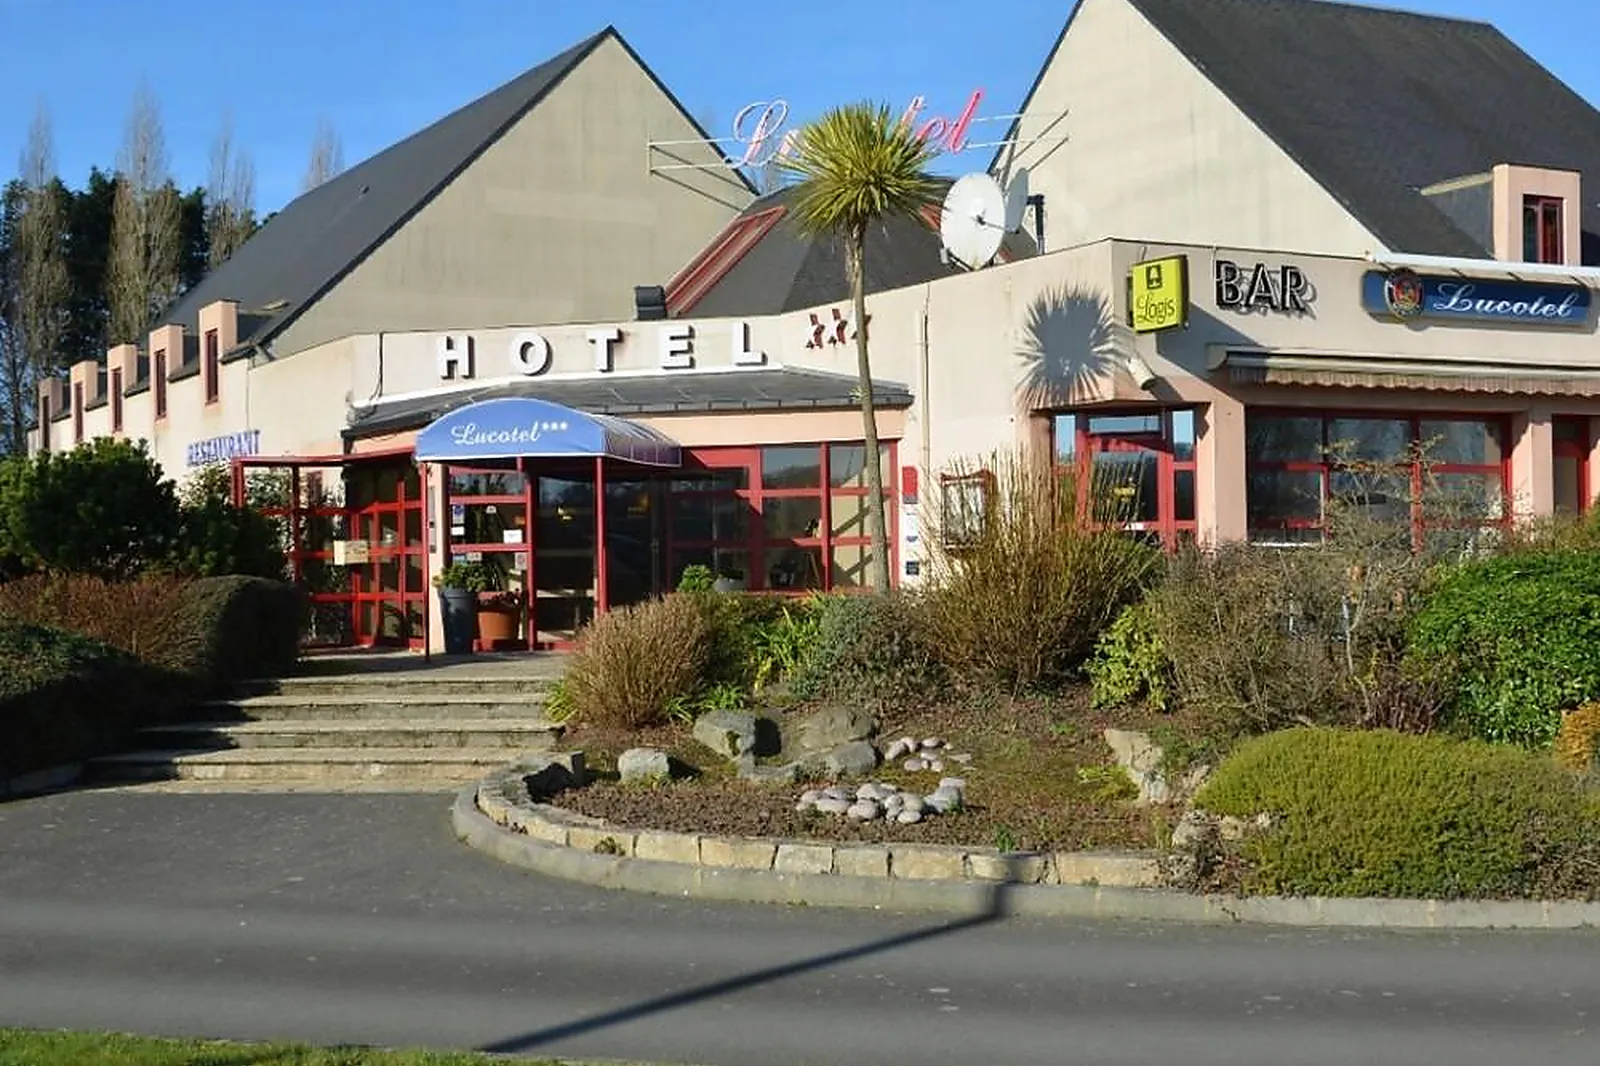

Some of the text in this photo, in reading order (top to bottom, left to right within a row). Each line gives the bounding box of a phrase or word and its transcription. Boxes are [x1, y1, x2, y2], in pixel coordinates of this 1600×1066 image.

[1215, 260, 1309, 312] BAR
[1432, 282, 1580, 318] Lucotel
[1136, 292, 1176, 325] Logis
[436, 322, 766, 380] HOTEL
[450, 421, 541, 445] Lucotel
